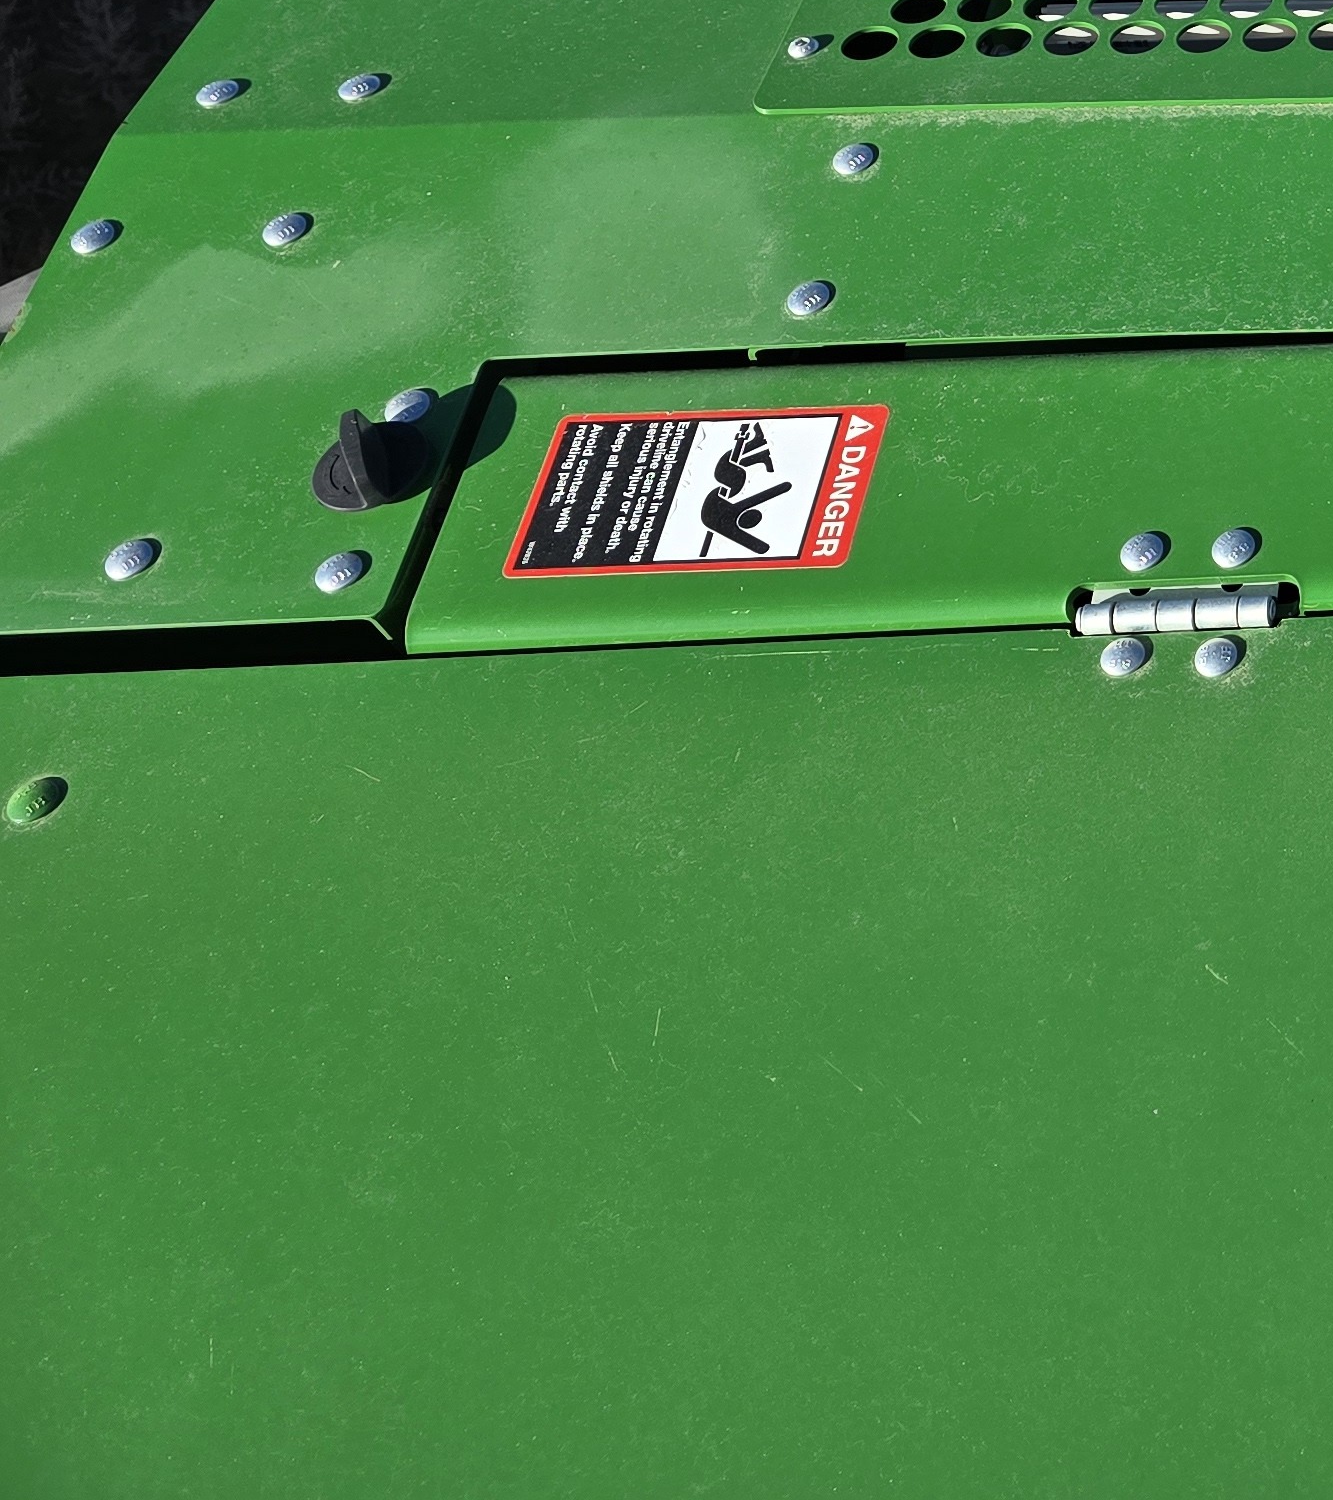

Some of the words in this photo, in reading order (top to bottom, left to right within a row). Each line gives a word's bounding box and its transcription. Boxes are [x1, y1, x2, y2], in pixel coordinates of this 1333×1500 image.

[560, 424, 589, 470] rotating
[581, 423, 605, 457] Avoid
[610, 422, 634, 453] Keep
[636, 422, 659, 464] serious
[649, 421, 676, 470] driveline
[605, 454, 620, 469] all
[652, 420, 691, 501] Entanglement
[549, 472, 571, 507] parts.
[564, 458, 589, 505] contact
[590, 470, 615, 512] shields
[622, 465, 648, 499] injury
[640, 471, 656, 494] can
[553, 506, 573, 533] with
[585, 513, 601, 525] in
[619, 500, 632, 515] or
[627, 495, 648, 532] cause
[647, 501, 664, 514] in
[811, 445, 867, 557] DANGER
[571, 526, 594, 563] place.
[604, 516, 628, 554] death.
[628, 515, 656, 563] rotating
